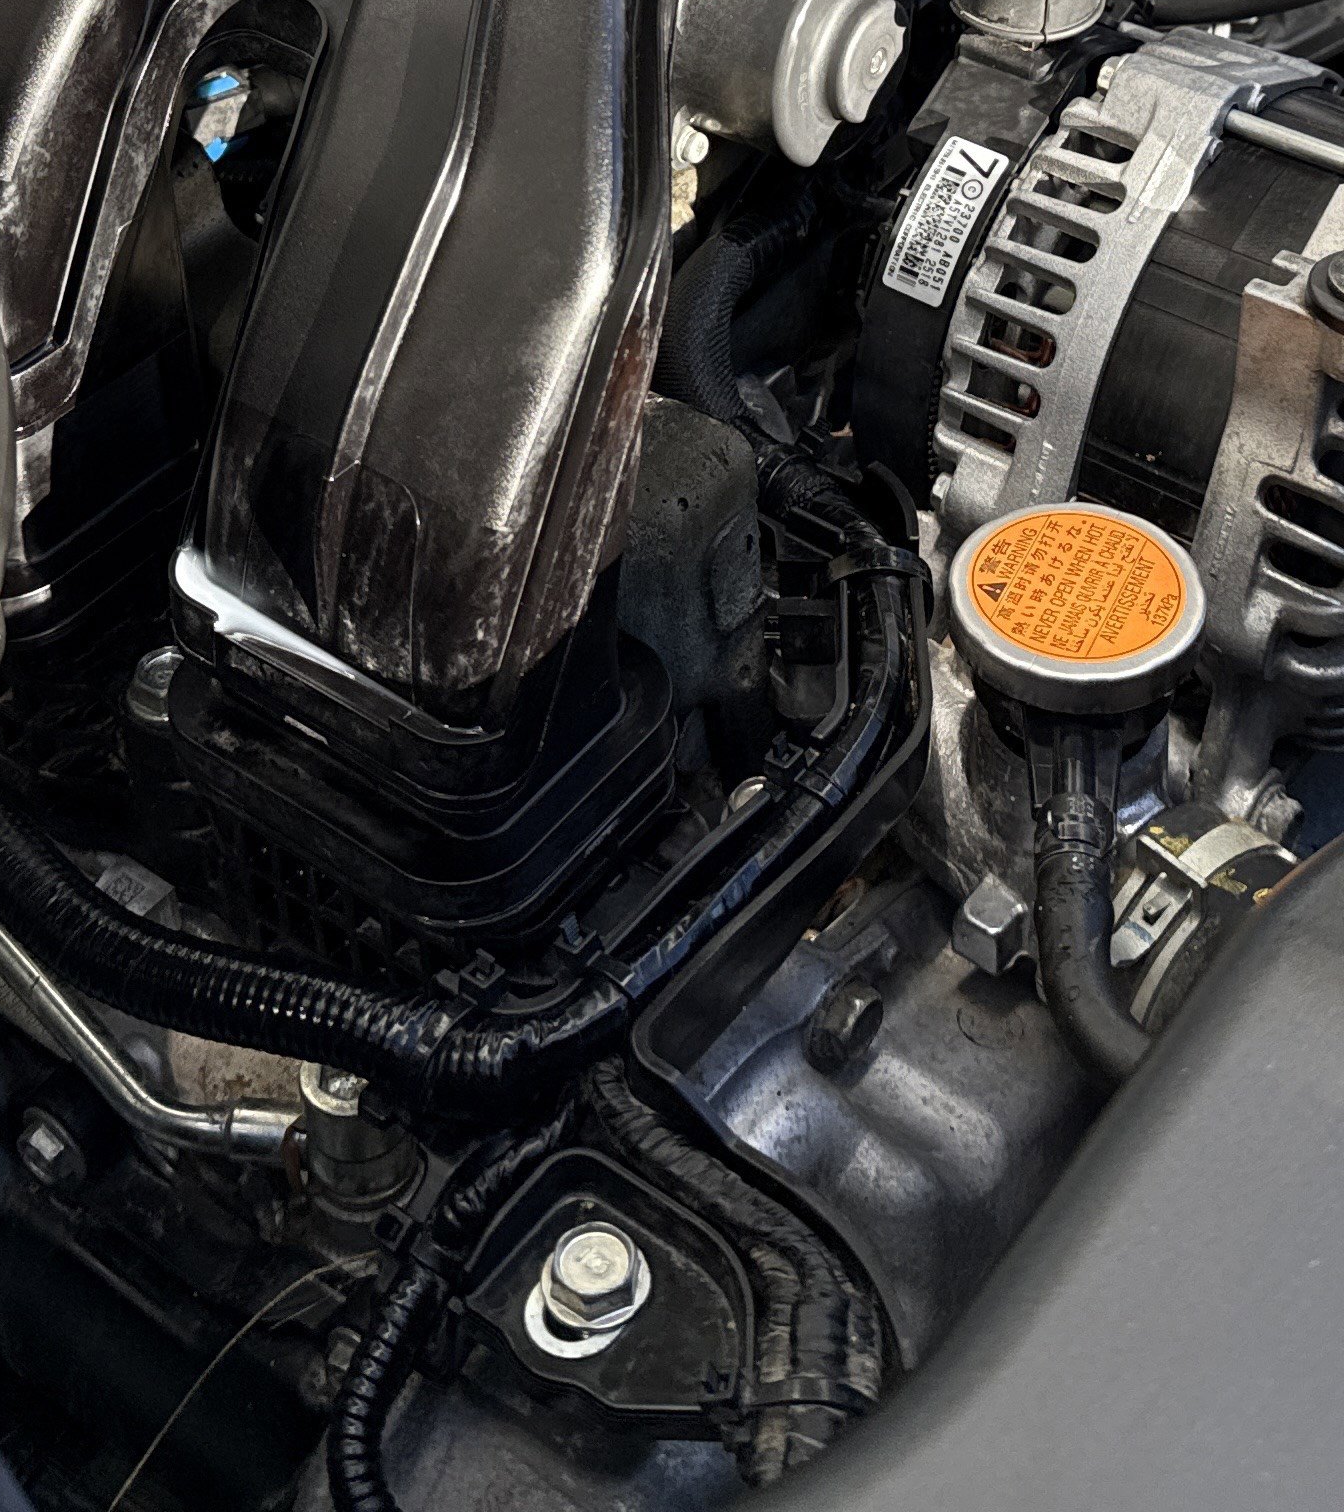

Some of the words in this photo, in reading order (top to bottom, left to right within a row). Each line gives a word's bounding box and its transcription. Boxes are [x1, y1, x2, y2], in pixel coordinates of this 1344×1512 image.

[930, 139, 959, 181] MITSUBISHI
[959, 148, 1000, 180] 7
[908, 183, 932, 222] ELECTRIC
[948, 203, 976, 244] 23700
[887, 223, 913, 277] CORPORATION
[917, 258, 937, 288] 2518
[929, 250, 954, 292] AB051
[979, 538, 1012, 575] 警告
[998, 527, 1038, 584] WARNING
[1029, 609, 1060, 643] NEVER
[1050, 578, 1076, 607] OPEN
[1065, 546, 1094, 576] WHEN
[1076, 569, 1107, 602] OUVRIR
[1100, 556, 1155, 644] AVERTISSEMENT
[1059, 603, 1087, 636] JAMAIS
[1151, 594, 1179, 631] 137kPa
[1050, 634, 1069, 650] NE
